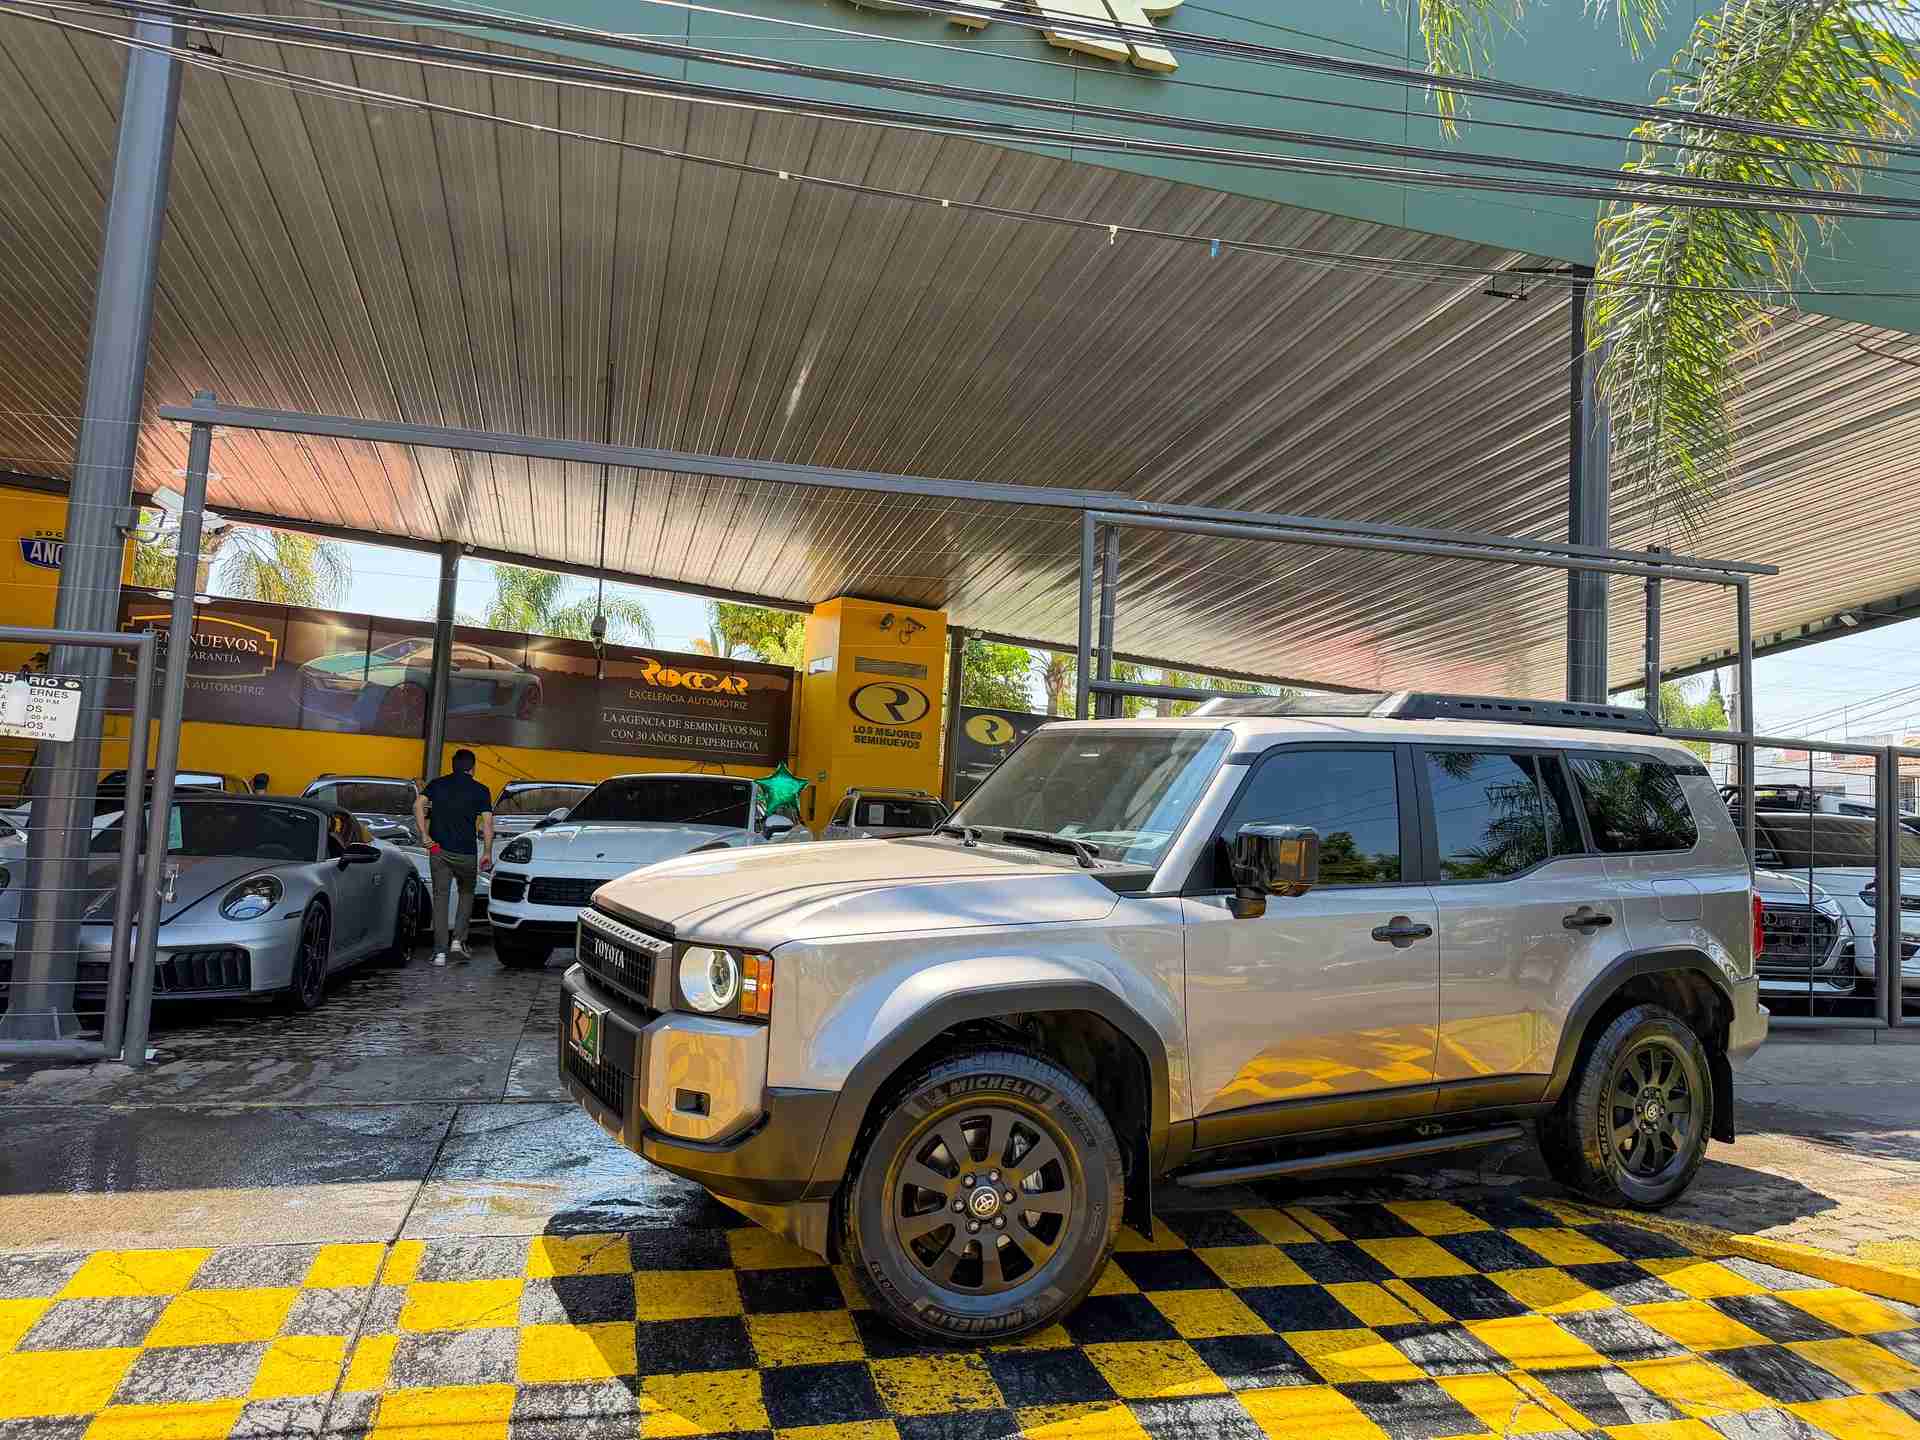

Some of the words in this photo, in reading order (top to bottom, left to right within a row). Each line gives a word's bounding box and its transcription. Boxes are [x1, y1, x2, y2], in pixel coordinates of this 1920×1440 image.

[31, 541, 64, 565] ANC
[31, 688, 69, 699] ERNES
[629, 688, 685, 703] EXCELENCIA
[687, 696, 748, 711] AUTOMOTRIZ
[603, 711, 618, 723] LA
[619, 713, 666, 728] AGENCIA
[668, 719, 683, 729] DE
[684, 720, 748, 735] SEMINUEVOS
[853, 726, 874, 735] LOS
[875, 727, 922, 741] MEJORES
[611, 728, 635, 739] CON
[636, 730, 648, 740] 30
[649, 730, 679, 744] AÑOS
[680, 735, 694, 745] DE
[695, 736, 759, 751] EXPERIENCIA
[854, 735, 921, 749] SEMINUEVOS
[594, 937, 625, 969] TOYOTA
[948, 1074, 1048, 1103] MICHELIN
